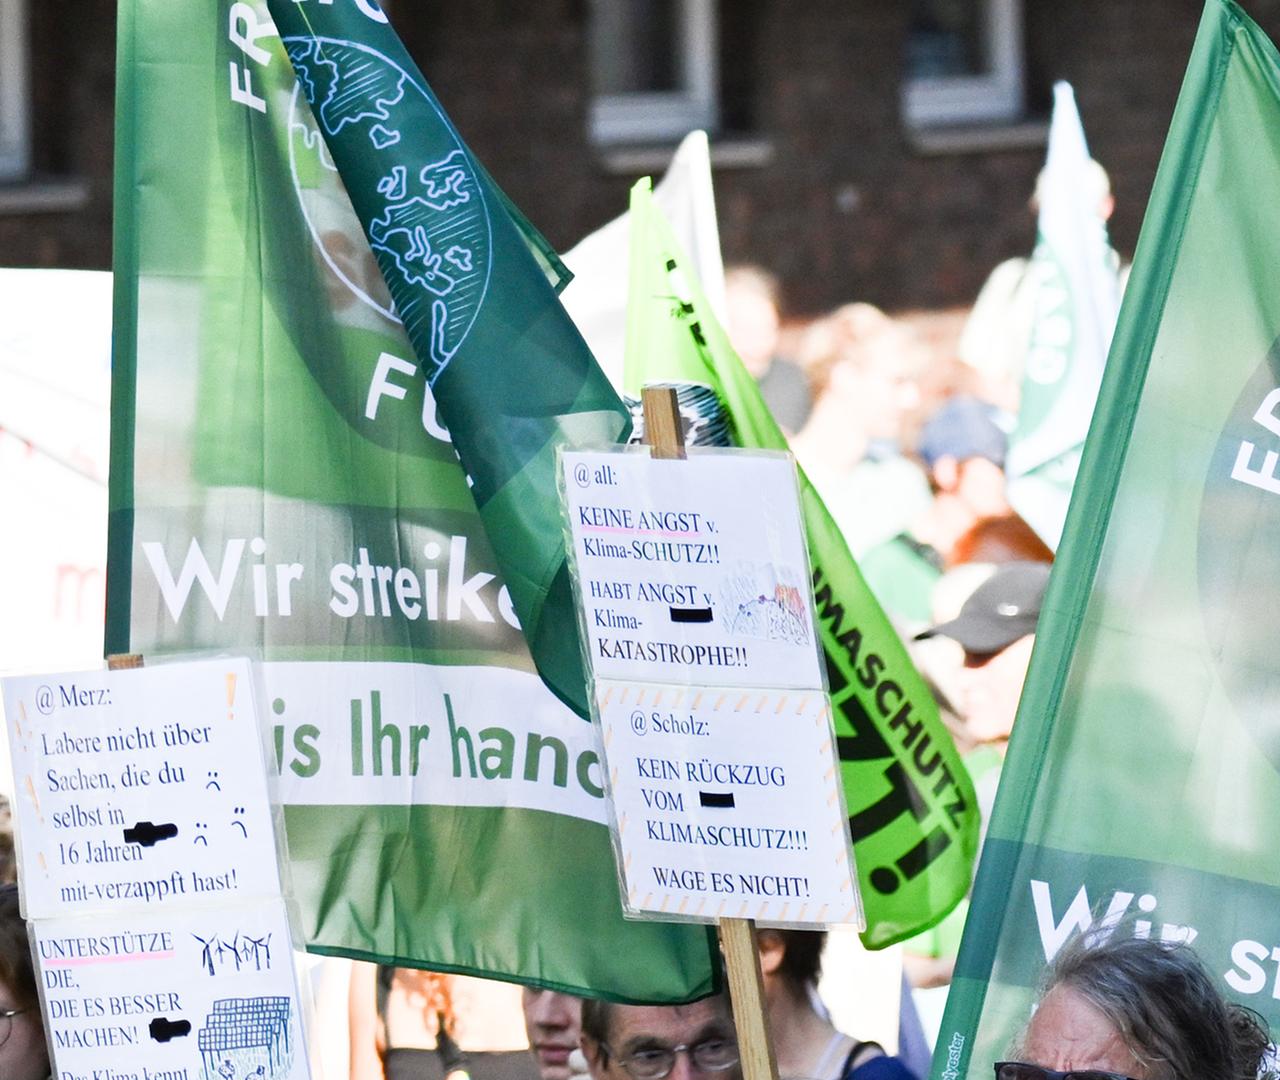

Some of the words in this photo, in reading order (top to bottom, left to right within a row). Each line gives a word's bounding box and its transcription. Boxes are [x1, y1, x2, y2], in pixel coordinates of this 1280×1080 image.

[574, 463, 592, 488] @
[594, 465, 618, 486] all:
[578, 506, 634, 529] KEINE
[638, 511, 700, 533] ANGST
[706, 521, 719, 533] v.
[583, 538, 720, 564] Klima-SCHUTZ!!
[142, 537, 303, 624] Wir
[590, 581, 632, 601] HABT
[637, 582, 697, 606] ANGST
[703, 592, 716, 606] v.
[594, 609, 643, 630] Klima-
[598, 638, 749, 667] KATASTROPHE!!
[35, 685, 55, 715] @
[59, 685, 112, 707] Merz:
[350, 690, 430, 778] Ihr
[630, 710, 648, 736] @
[651, 712, 710, 736] Scholz:
[41, 732, 101, 756] Labere
[107, 728, 156, 752] nicht
[164, 723, 212, 748] über
[47, 765, 116, 793] Sachen,
[120, 763, 151, 788] die
[158, 761, 186, 784] du
[636, 757, 681, 779] KEIN
[686, 759, 786, 786] RÜCKZUG
[641, 789, 684, 812] VOM
[52, 804, 103, 829] selbst
[107, 803, 125, 826] in
[646, 820, 808, 850] KLIMASCHUTZ!!!
[59, 843, 80, 865] 16
[85, 840, 143, 864] Jahren
[60, 870, 186, 903] mit-verzappft
[193, 868, 239, 893] hast!
[653, 866, 707, 892] WAGE
[711, 872, 735, 894] ES
[739, 875, 810, 898] NICHT!
[39, 931, 174, 960] UNTERSTÜTZE
[45, 969, 80, 990] DIE,
[50, 999, 78, 1020] DIE
[84, 998, 105, 1018] ES
[109, 992, 183, 1017] BESSER
[55, 1026, 139, 1049] MACHEN!
